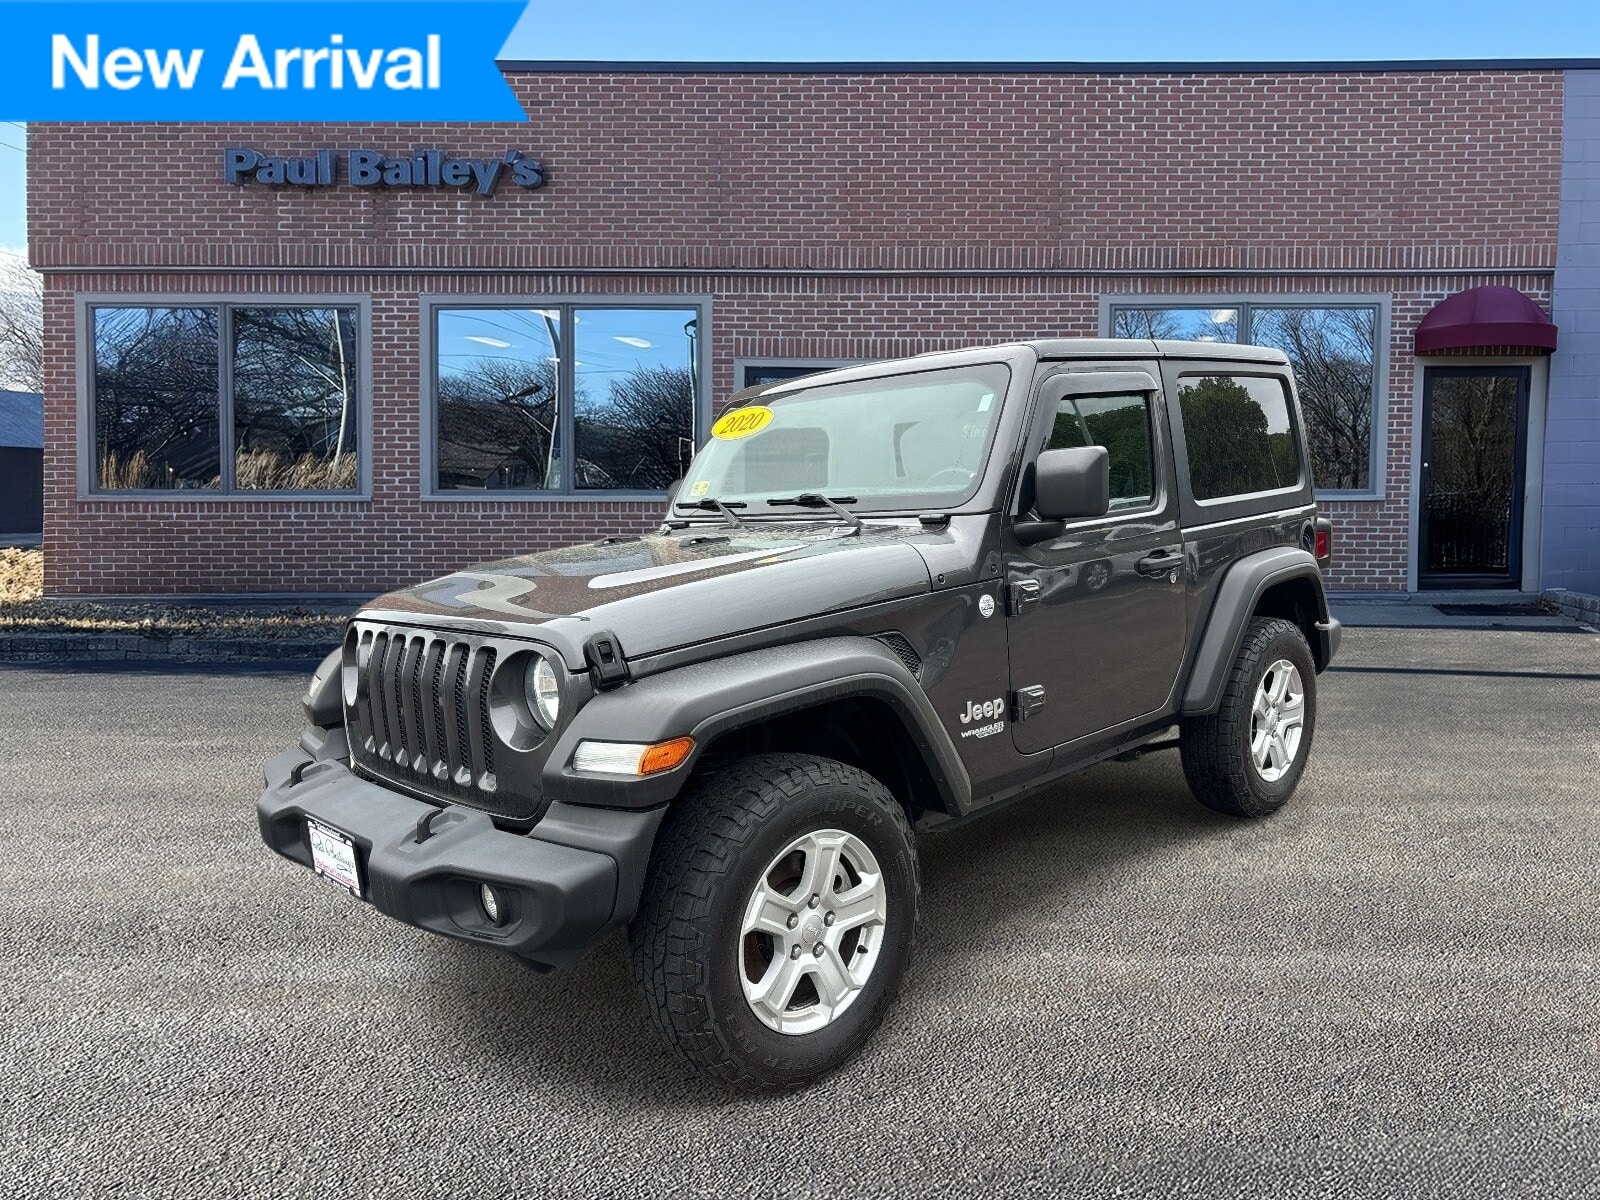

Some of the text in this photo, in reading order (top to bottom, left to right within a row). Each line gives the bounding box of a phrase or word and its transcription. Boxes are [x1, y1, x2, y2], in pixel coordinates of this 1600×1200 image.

[223, 148, 544, 196] Paul Bailey's
[718, 411, 765, 435] 2020
[959, 697, 1005, 724] Jeep
